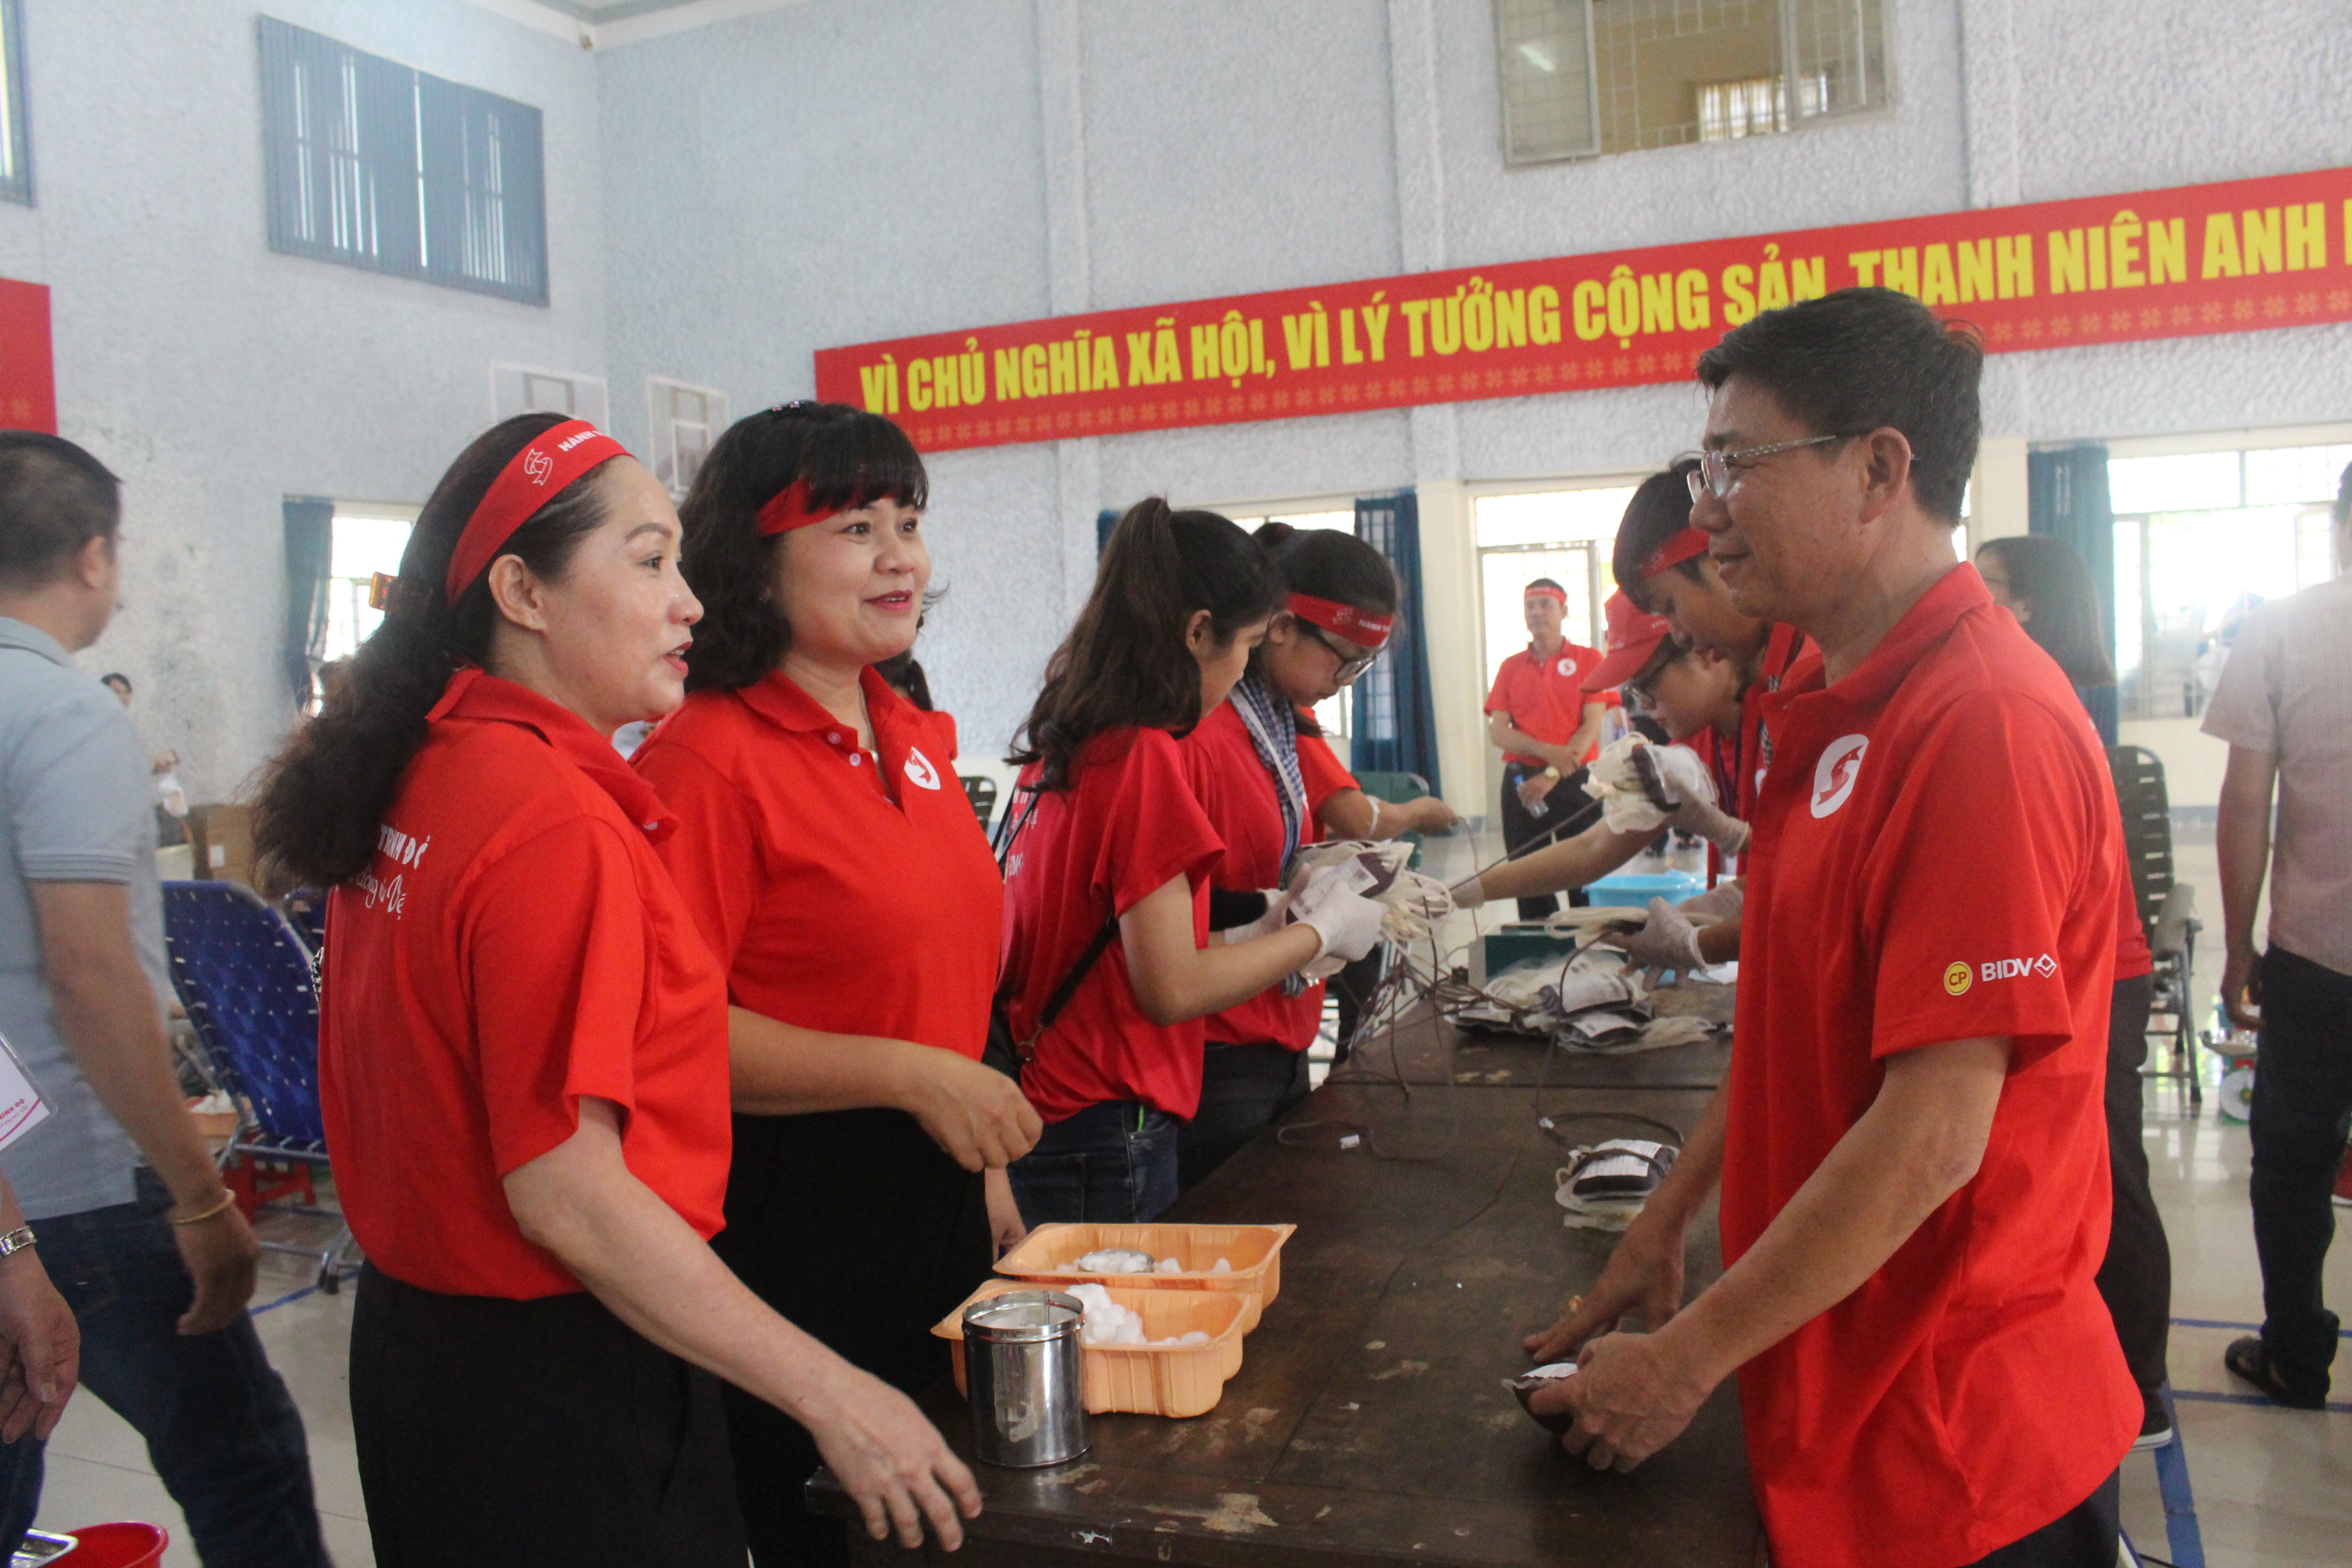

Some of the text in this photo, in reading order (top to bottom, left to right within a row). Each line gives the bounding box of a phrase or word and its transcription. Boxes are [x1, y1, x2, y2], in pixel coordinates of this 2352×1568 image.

[860, 353, 899, 415] VÌ
[908, 337, 985, 411] CHỦ
[995, 329, 1119, 400] NGHĨA
[1127, 317, 1182, 386] XÃ
[1191, 310, 1275, 388] HỘI,
[1283, 301, 1329, 369] VÌ
[1340, 291, 1389, 364] LÝ
[1401, 276, 1561, 357] TƯỞNG
[1573, 266, 1710, 348] CỘNG
[1722, 243, 1826, 327] SẢN
[1849, 235, 2034, 307] THANH
[2049, 210, 2186, 293] NIÊN
[2202, 203, 2326, 278] ANH
[1948, 971, 1967, 986] CP
[1980, 957, 2034, 982] BIDV
